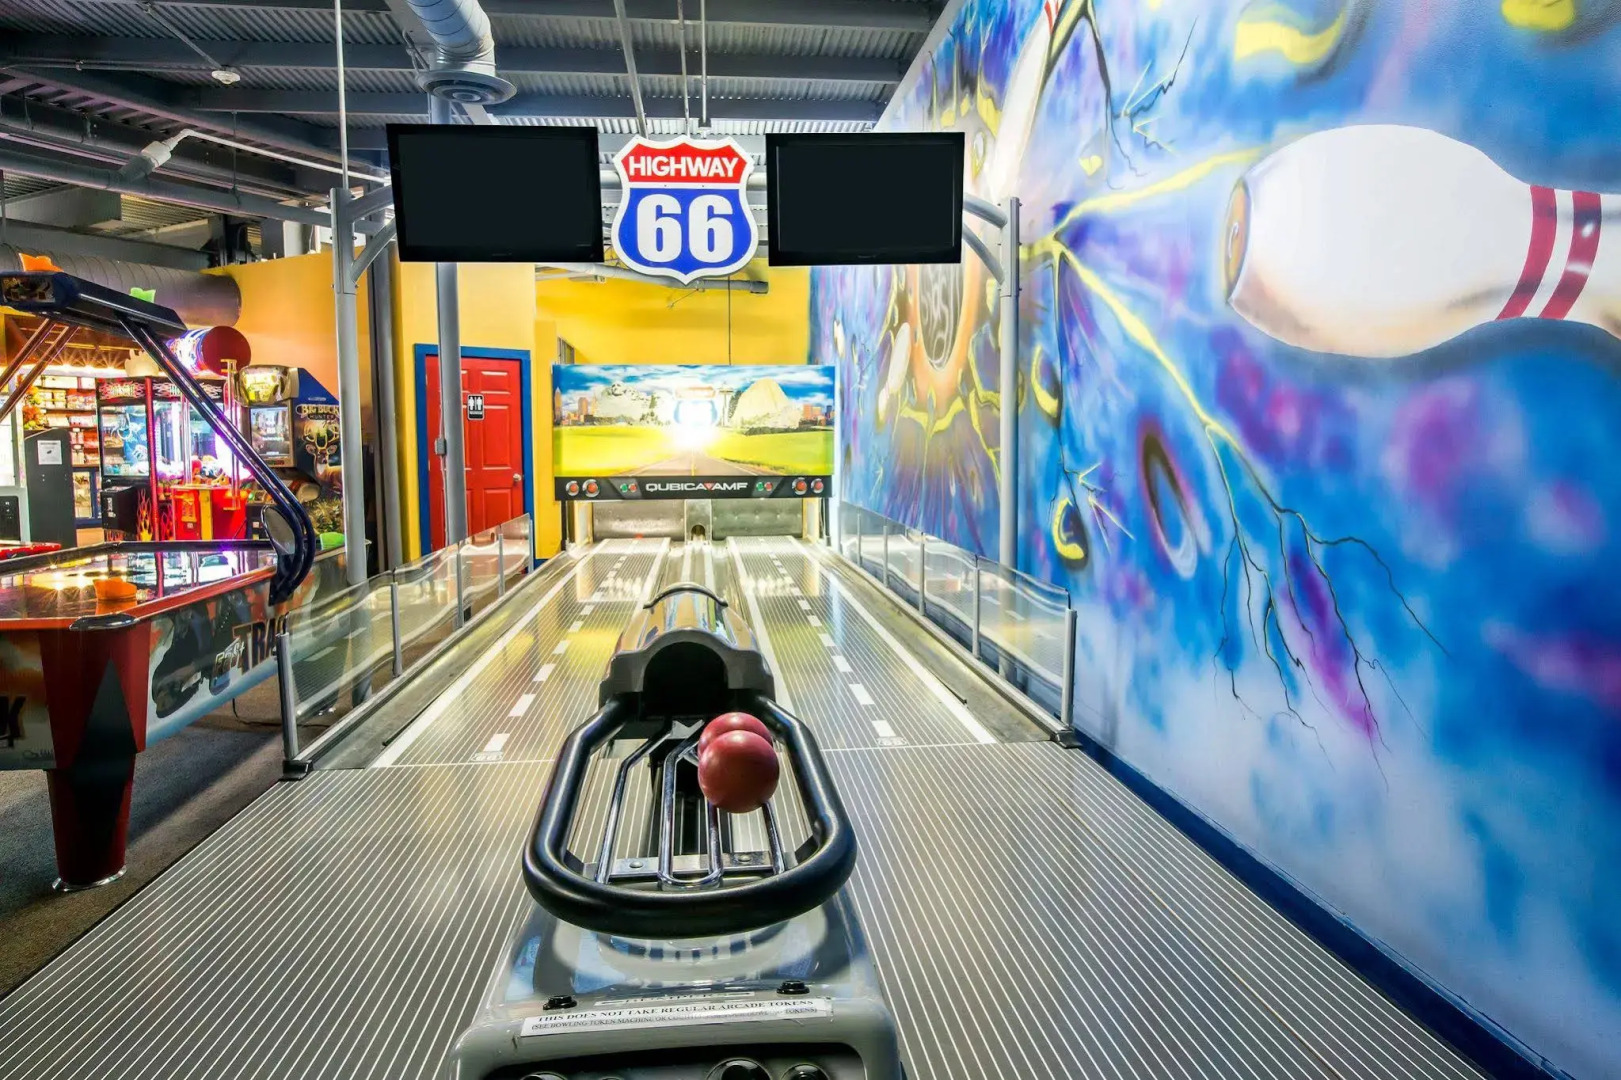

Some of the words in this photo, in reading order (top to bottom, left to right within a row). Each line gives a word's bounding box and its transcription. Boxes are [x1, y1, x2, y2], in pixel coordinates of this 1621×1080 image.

[628, 155, 739, 178] HIGHWAY
[636, 193, 734, 264] 66
[301, 404, 316, 415] BIG
[317, 404, 340, 415] BUCK
[645, 482, 706, 493] QUBICA
[711, 482, 749, 491] AMF
[537, 1014, 563, 1022] THIS
[566, 1012, 597, 1020] DOES
[600, 1010, 625, 1018] NOT
[627, 1008, 658, 1016] TAKE
[661, 1004, 716, 1014] REGULAR
[718, 1002, 763, 1011] ARCADE
[768, 1000, 814, 1008] TOKENS
[551, 1020, 588, 1029] BOWLING
[589, 1018, 616, 1026] TOKEN
[617, 1016, 654, 1025] MACHINE
